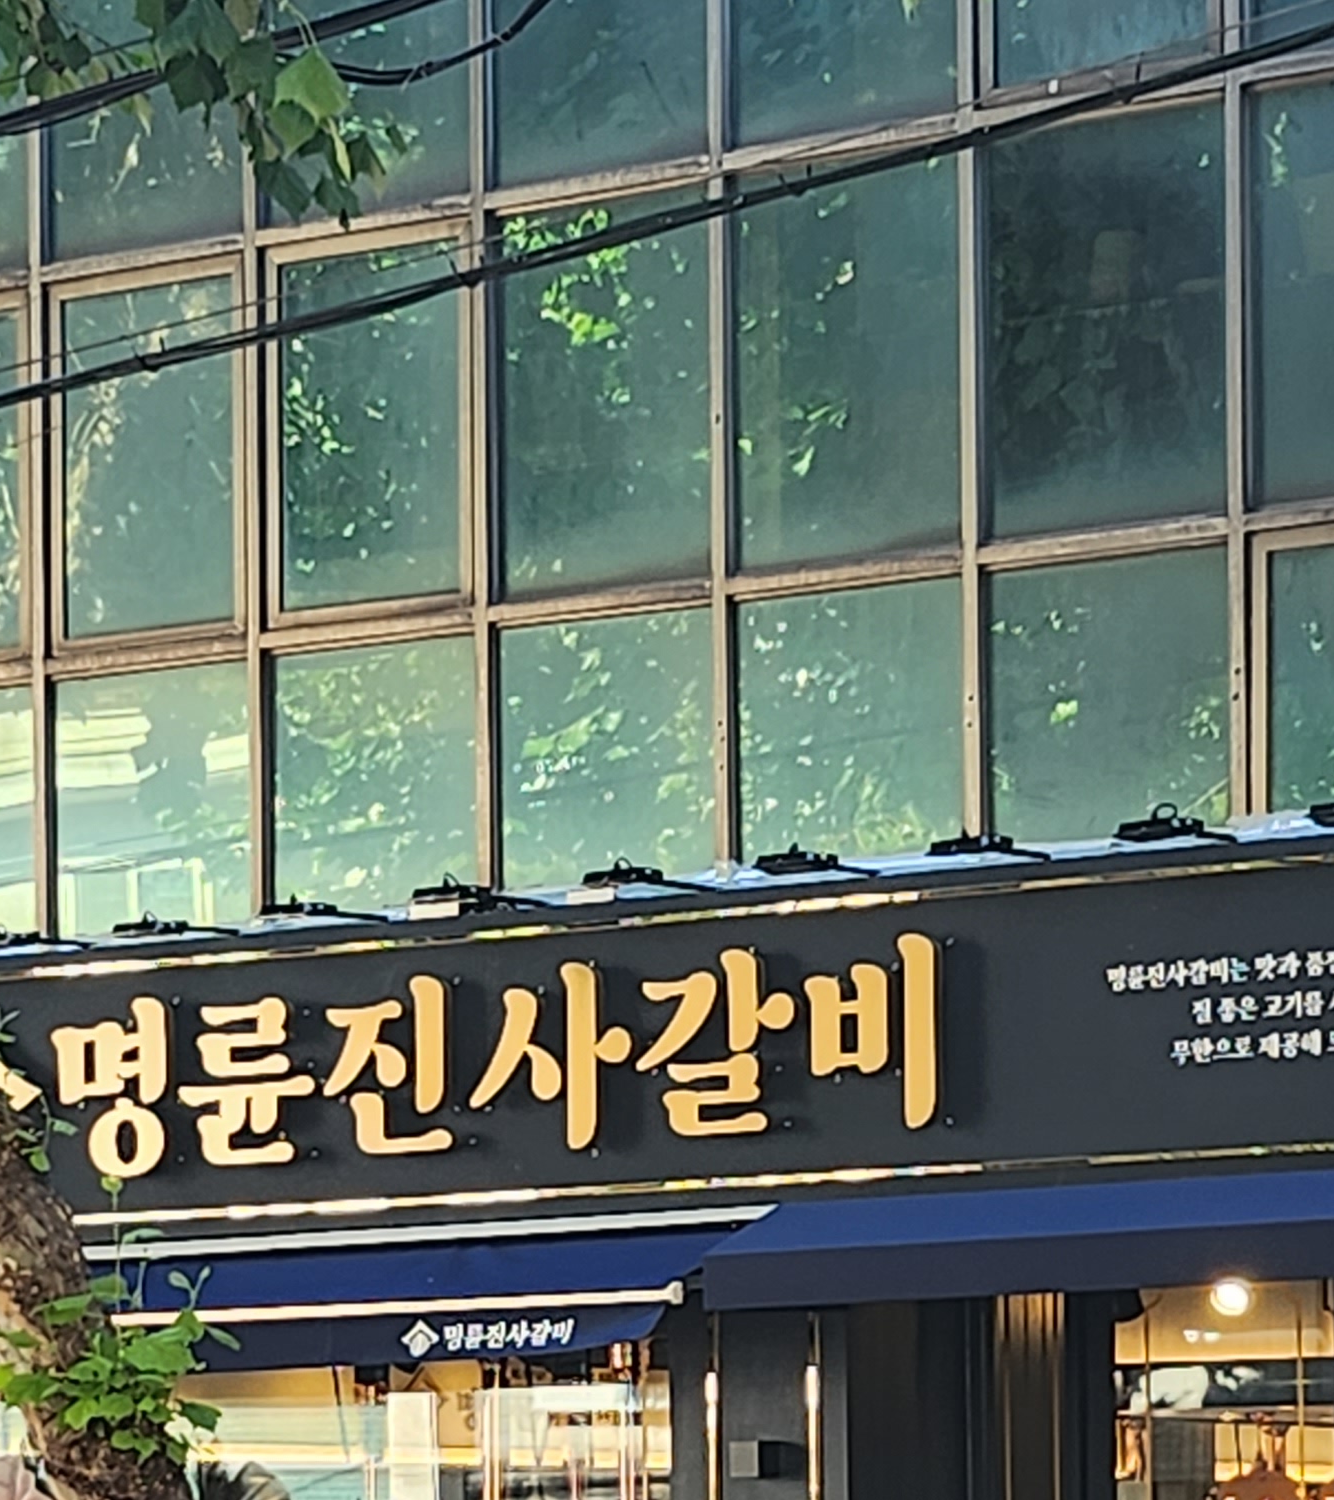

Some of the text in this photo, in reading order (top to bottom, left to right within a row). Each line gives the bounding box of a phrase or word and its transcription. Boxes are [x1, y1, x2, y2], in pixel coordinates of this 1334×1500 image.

[1106, 958, 1250, 992] 명륜진사갈비는
[1254, 952, 1301, 981] 맛과
[1217, 996, 1260, 1023] 좋은
[1263, 991, 1325, 1018] 고기를
[50, 931, 937, 1178] 명륜진사갈비
[1170, 1036, 1255, 1066] 무한으로
[1258, 1029, 1323, 1059] 제공해
[442, 1317, 575, 1351] 명륜진사갈비
